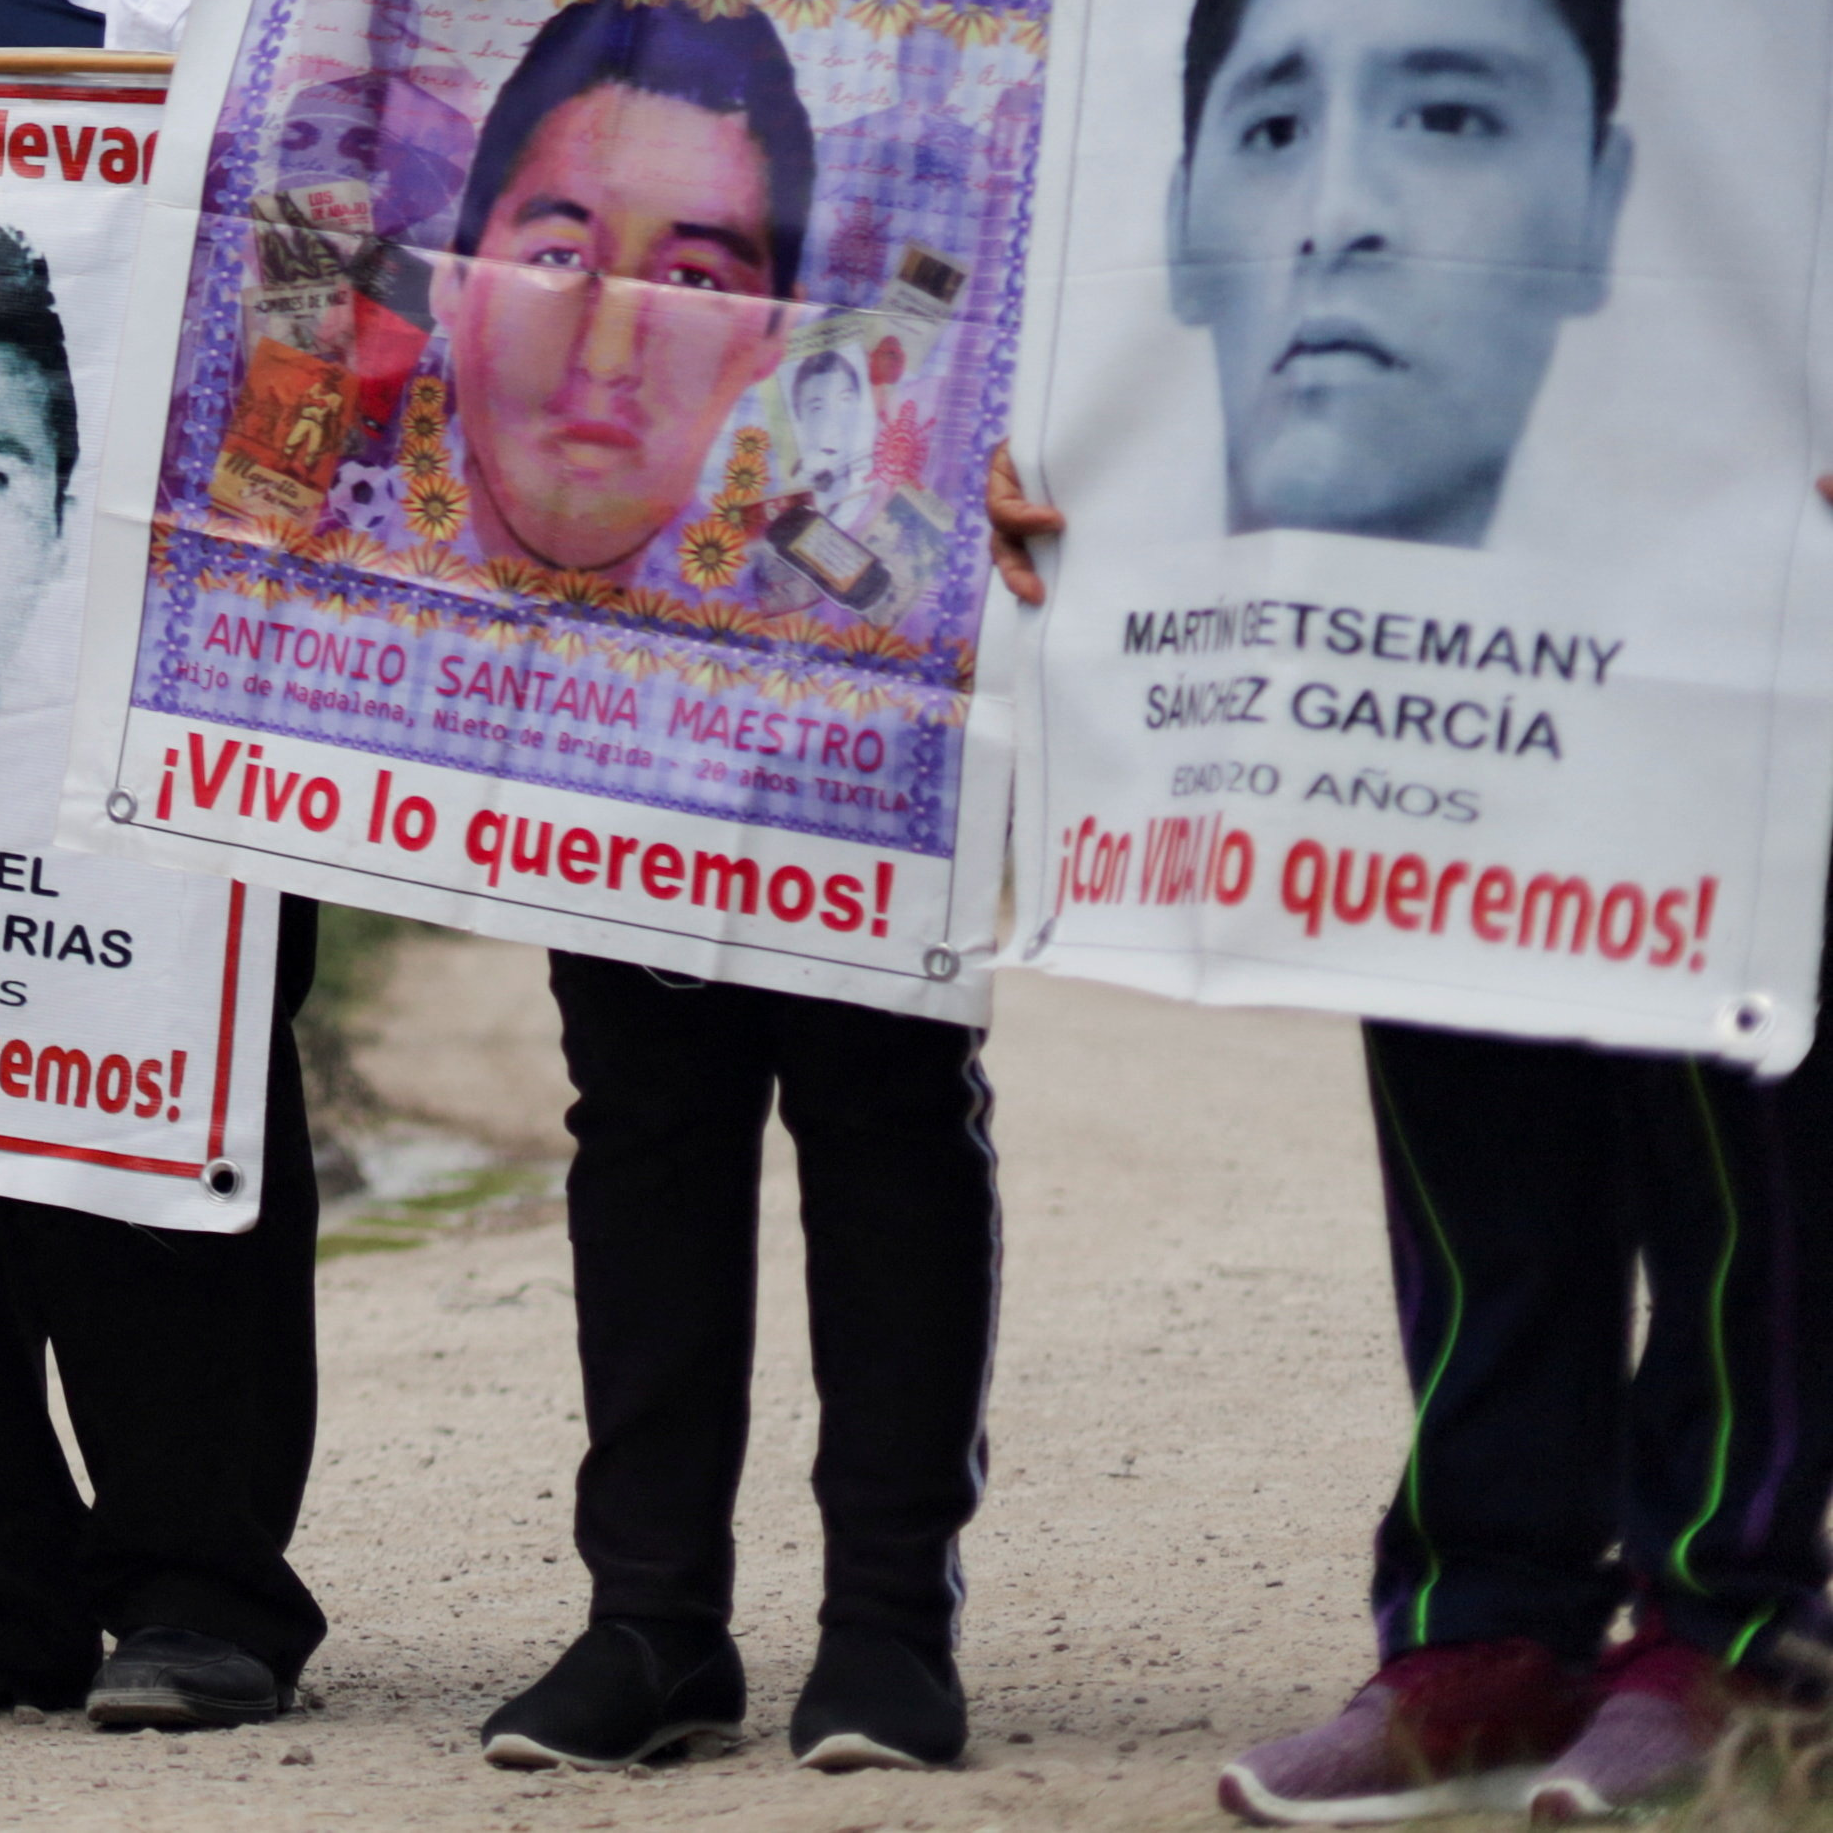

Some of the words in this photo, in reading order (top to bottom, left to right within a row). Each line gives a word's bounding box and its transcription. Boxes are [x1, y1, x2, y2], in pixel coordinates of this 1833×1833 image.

[203, 613, 406, 685] ANTONIO
[435, 654, 638, 731] SANTANA
[668, 697, 886, 774] MAESTRO
[1124, 594, 1234, 655] MARTÍN
[1241, 600, 1625, 687] GETSEMANY
[244, 673, 273, 697] de
[283, 680, 416, 728] Magdalena,
[433, 708, 508, 742] Nieto
[519, 726, 545, 748] de
[556, 730, 654, 769] Brígida
[696, 757, 728, 781] 20
[738, 767, 798, 795] años
[814, 776, 912, 814] TIXTLA
[1145, 673, 1271, 731] SÁNCHEZ
[1290, 680, 1565, 763] GARCÍA
[156, 732, 341, 832] ¡Vivo
[369, 769, 438, 853] lo
[464, 807, 896, 939] queremos!
[1227, 760, 1282, 796] 20
[1303, 767, 1482, 825] AÑOS
[1201, 811, 1255, 907] lo
[1280, 837, 1720, 974] queremos!
